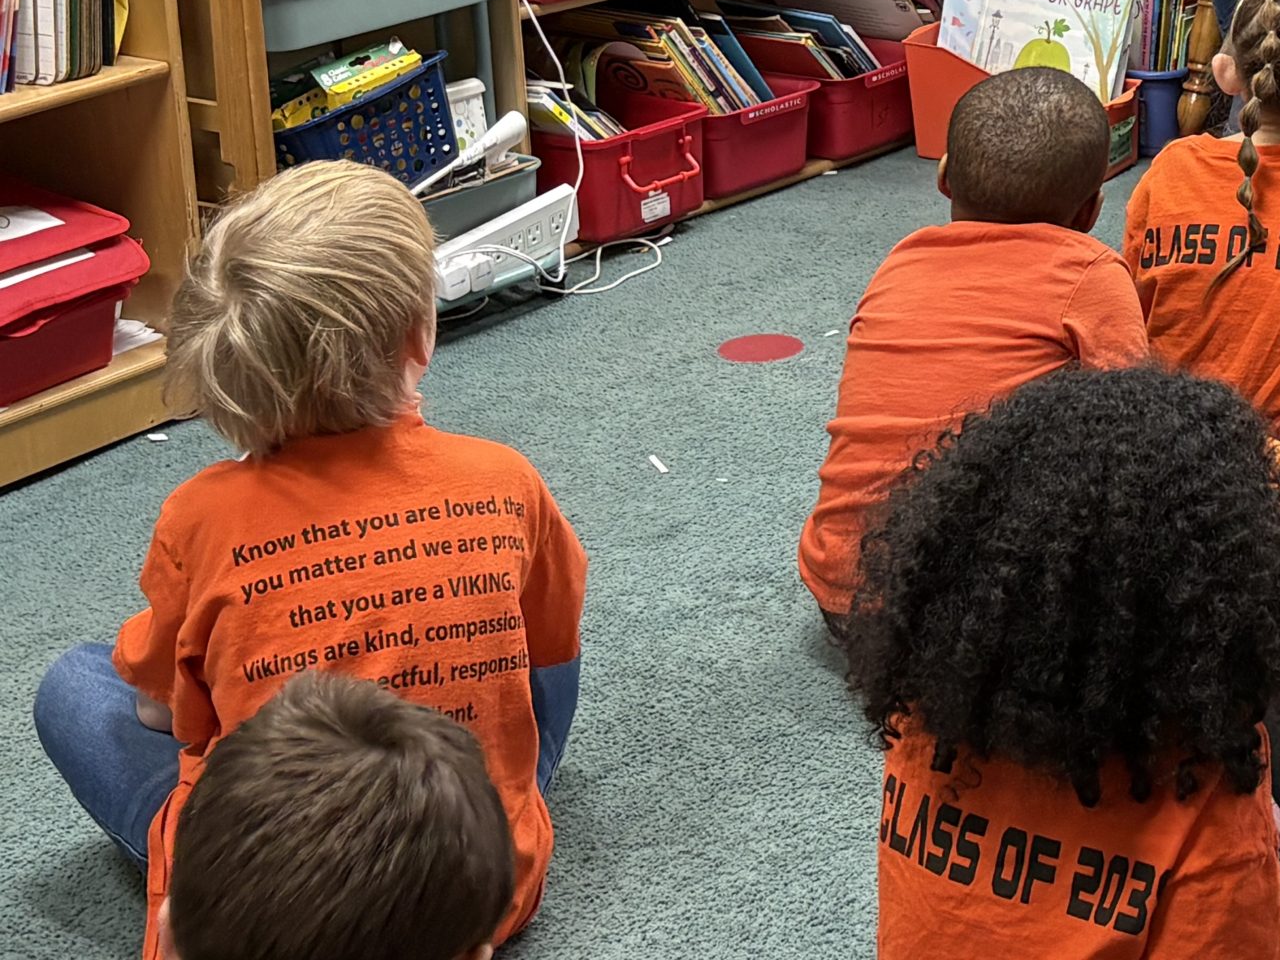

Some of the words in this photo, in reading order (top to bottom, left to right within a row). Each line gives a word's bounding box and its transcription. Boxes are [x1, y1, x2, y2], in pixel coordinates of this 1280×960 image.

[321, 74, 332, 86] 8
[754, 98, 801, 117] SCHOLASTIC
[1140, 224, 1220, 269] CLASS
[232, 533, 296, 567] Know
[301, 518, 352, 545] that
[356, 513, 400, 538] you
[405, 505, 441, 525] are
[445, 495, 501, 519] loved,
[240, 573, 284, 603] you
[288, 552, 367, 586] matter
[373, 539, 418, 567] and
[421, 540, 453, 558] we
[457, 534, 488, 553] are
[289, 601, 337, 629] that
[342, 591, 386, 620] you
[391, 585, 427, 605] are
[431, 583, 444, 599] a
[447, 572, 515, 597] VIKING.
[243, 647, 318, 683] Vikings
[324, 638, 360, 662] are
[364, 624, 420, 653] kind,
[880, 773, 988, 887] CLASS
[991, 826, 1061, 904] OF
